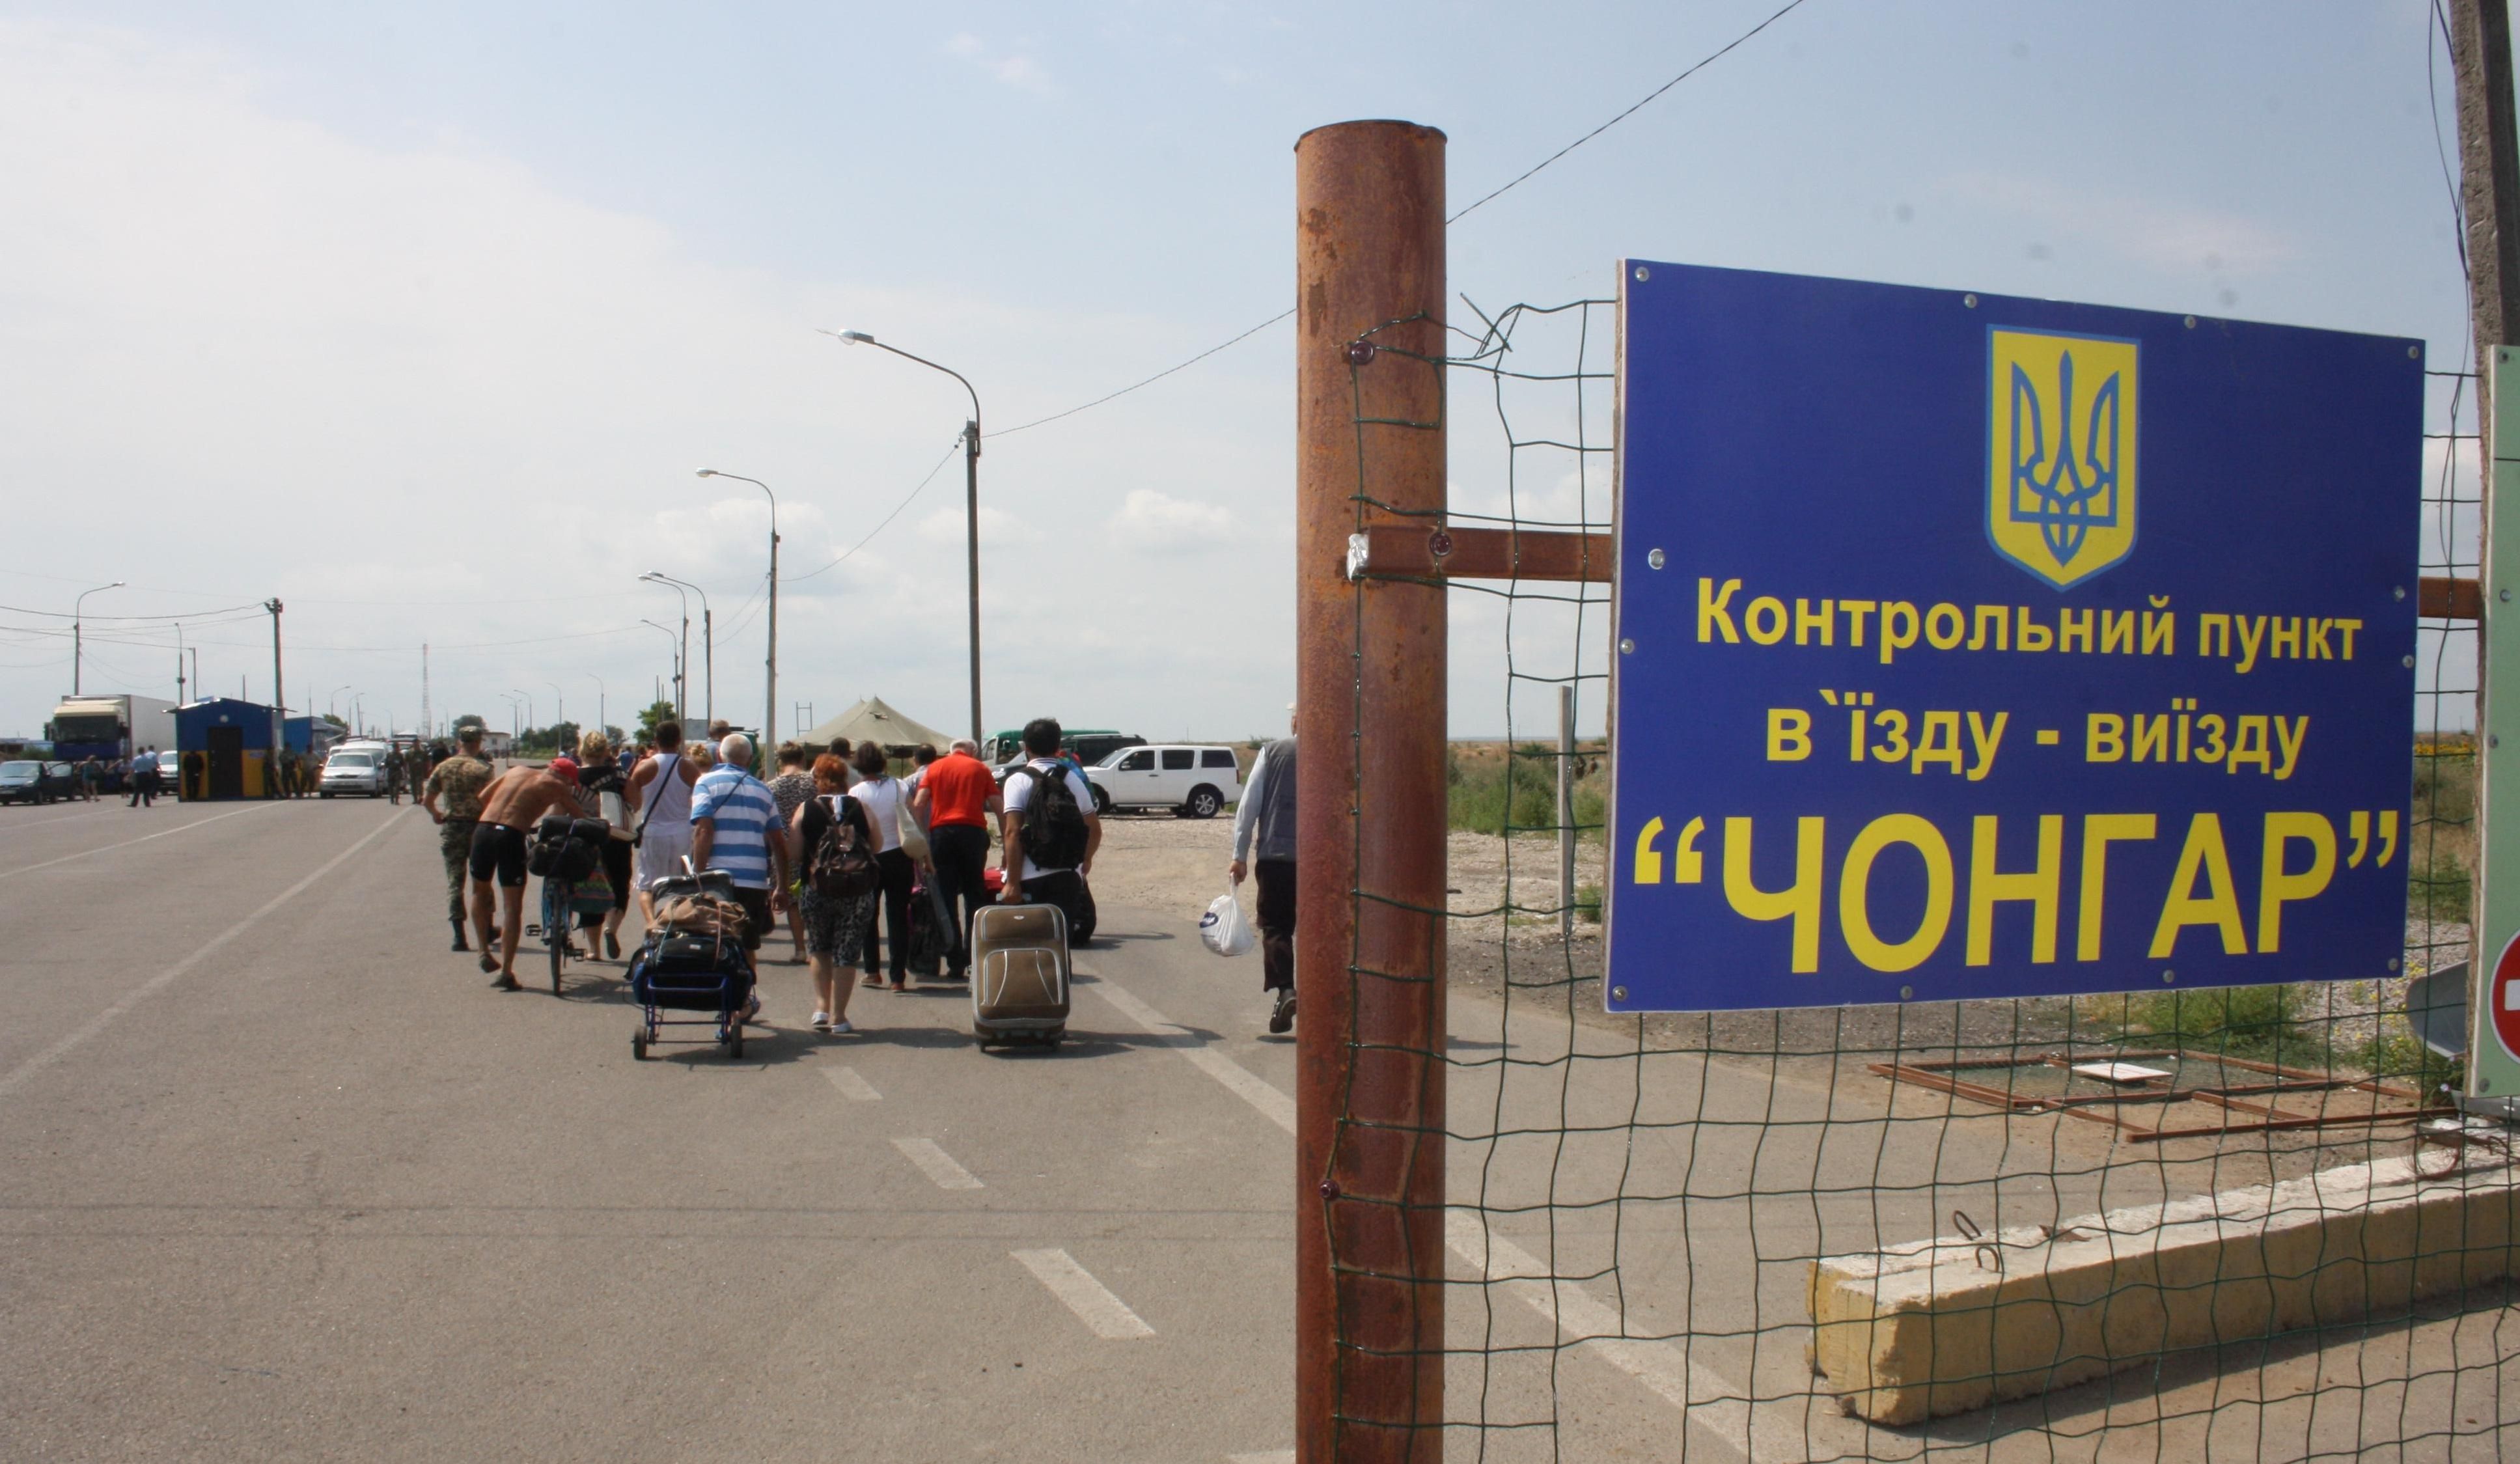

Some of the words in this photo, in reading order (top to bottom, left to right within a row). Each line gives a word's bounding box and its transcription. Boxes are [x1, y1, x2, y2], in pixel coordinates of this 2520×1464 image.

[1697, 577, 2175, 665] Контрольний
[2199, 613, 2363, 673] пункт
[2036, 729, 2060, 745] -
[2085, 698, 2310, 780] виїзду
